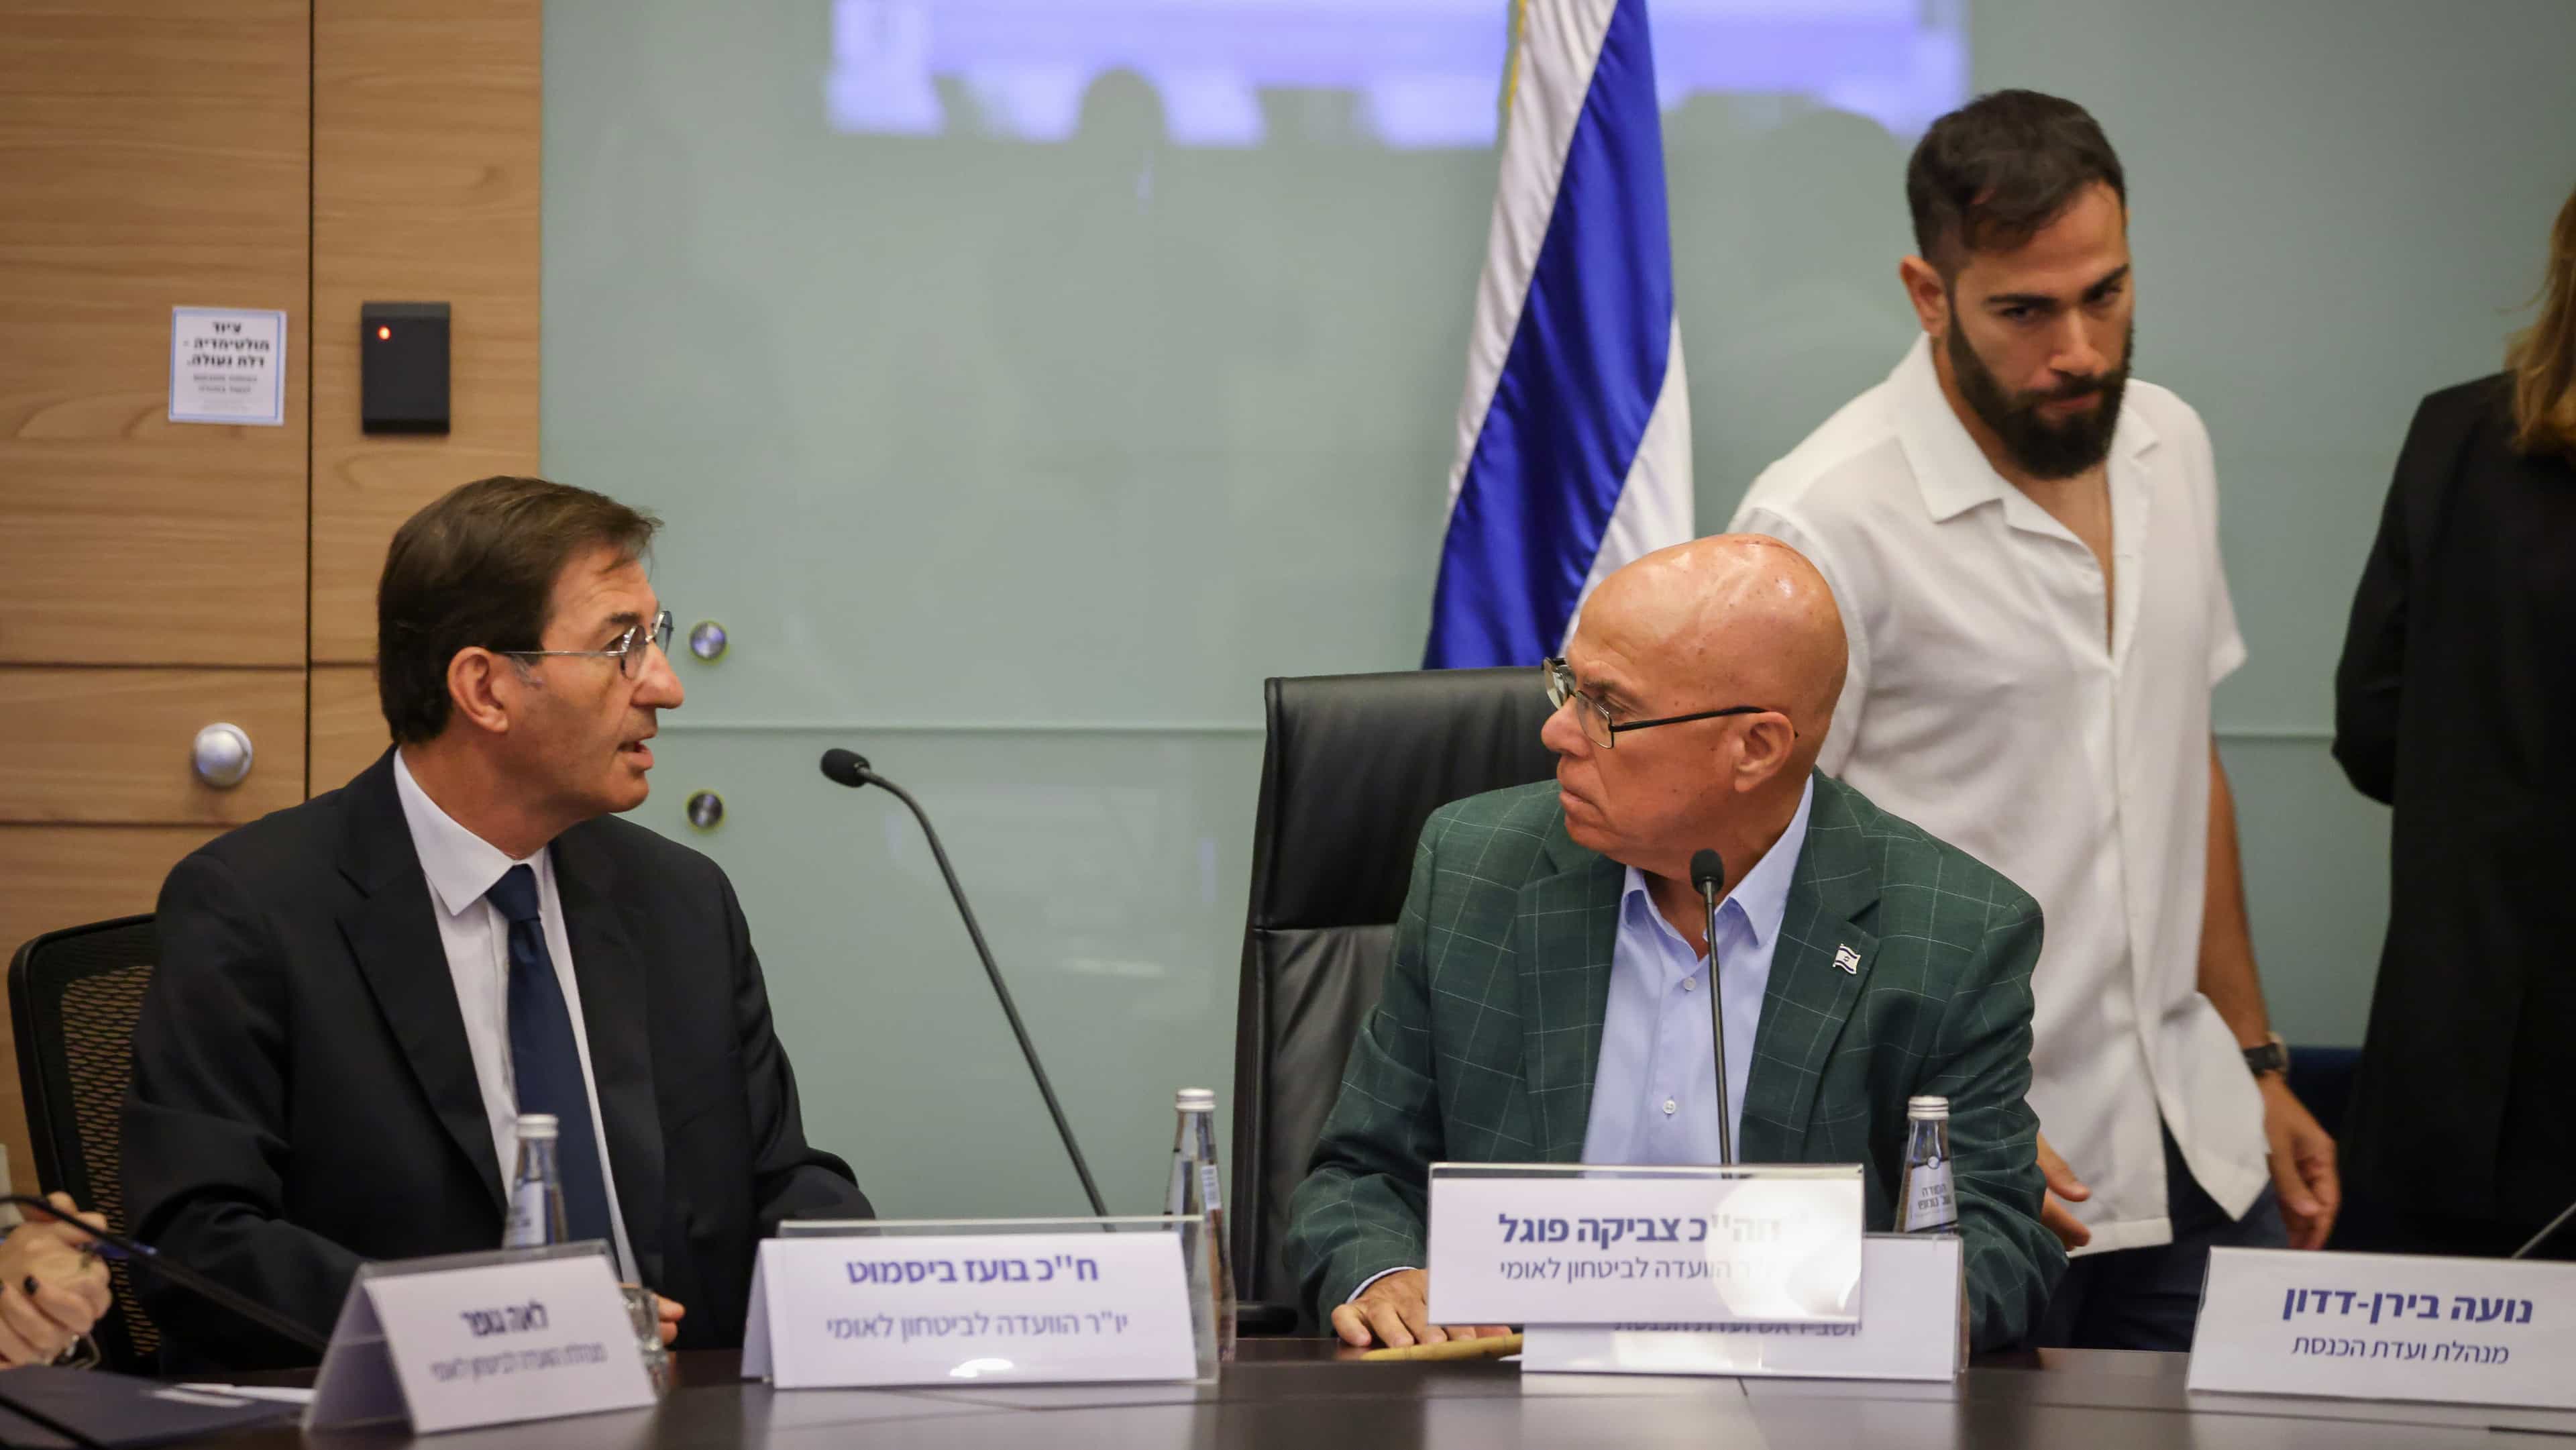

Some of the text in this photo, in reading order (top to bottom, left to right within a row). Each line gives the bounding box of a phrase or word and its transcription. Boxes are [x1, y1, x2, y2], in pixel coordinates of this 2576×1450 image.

[194, 337, 270, 350] מולטימדיה
[1498, 1213, 1570, 1243] פוגל
[1578, 1218, 1681, 1251] צביקה
[846, 1259, 959, 1284] ביסמוט
[964, 1259, 1030, 1284] בועז
[1500, 1257, 1562, 1280] לאומי
[1567, 1257, 1650, 1284] לביטחון
[2282, 1288, 2534, 1325] נועה בירן-דדון
[826, 1312, 894, 1339] לאומי
[901, 1311, 990, 1344] לביטחון
[996, 1312, 1080, 1336] הוועדה
[2292, 1337, 2510, 1364] מנהלת ועדת הכנסת
